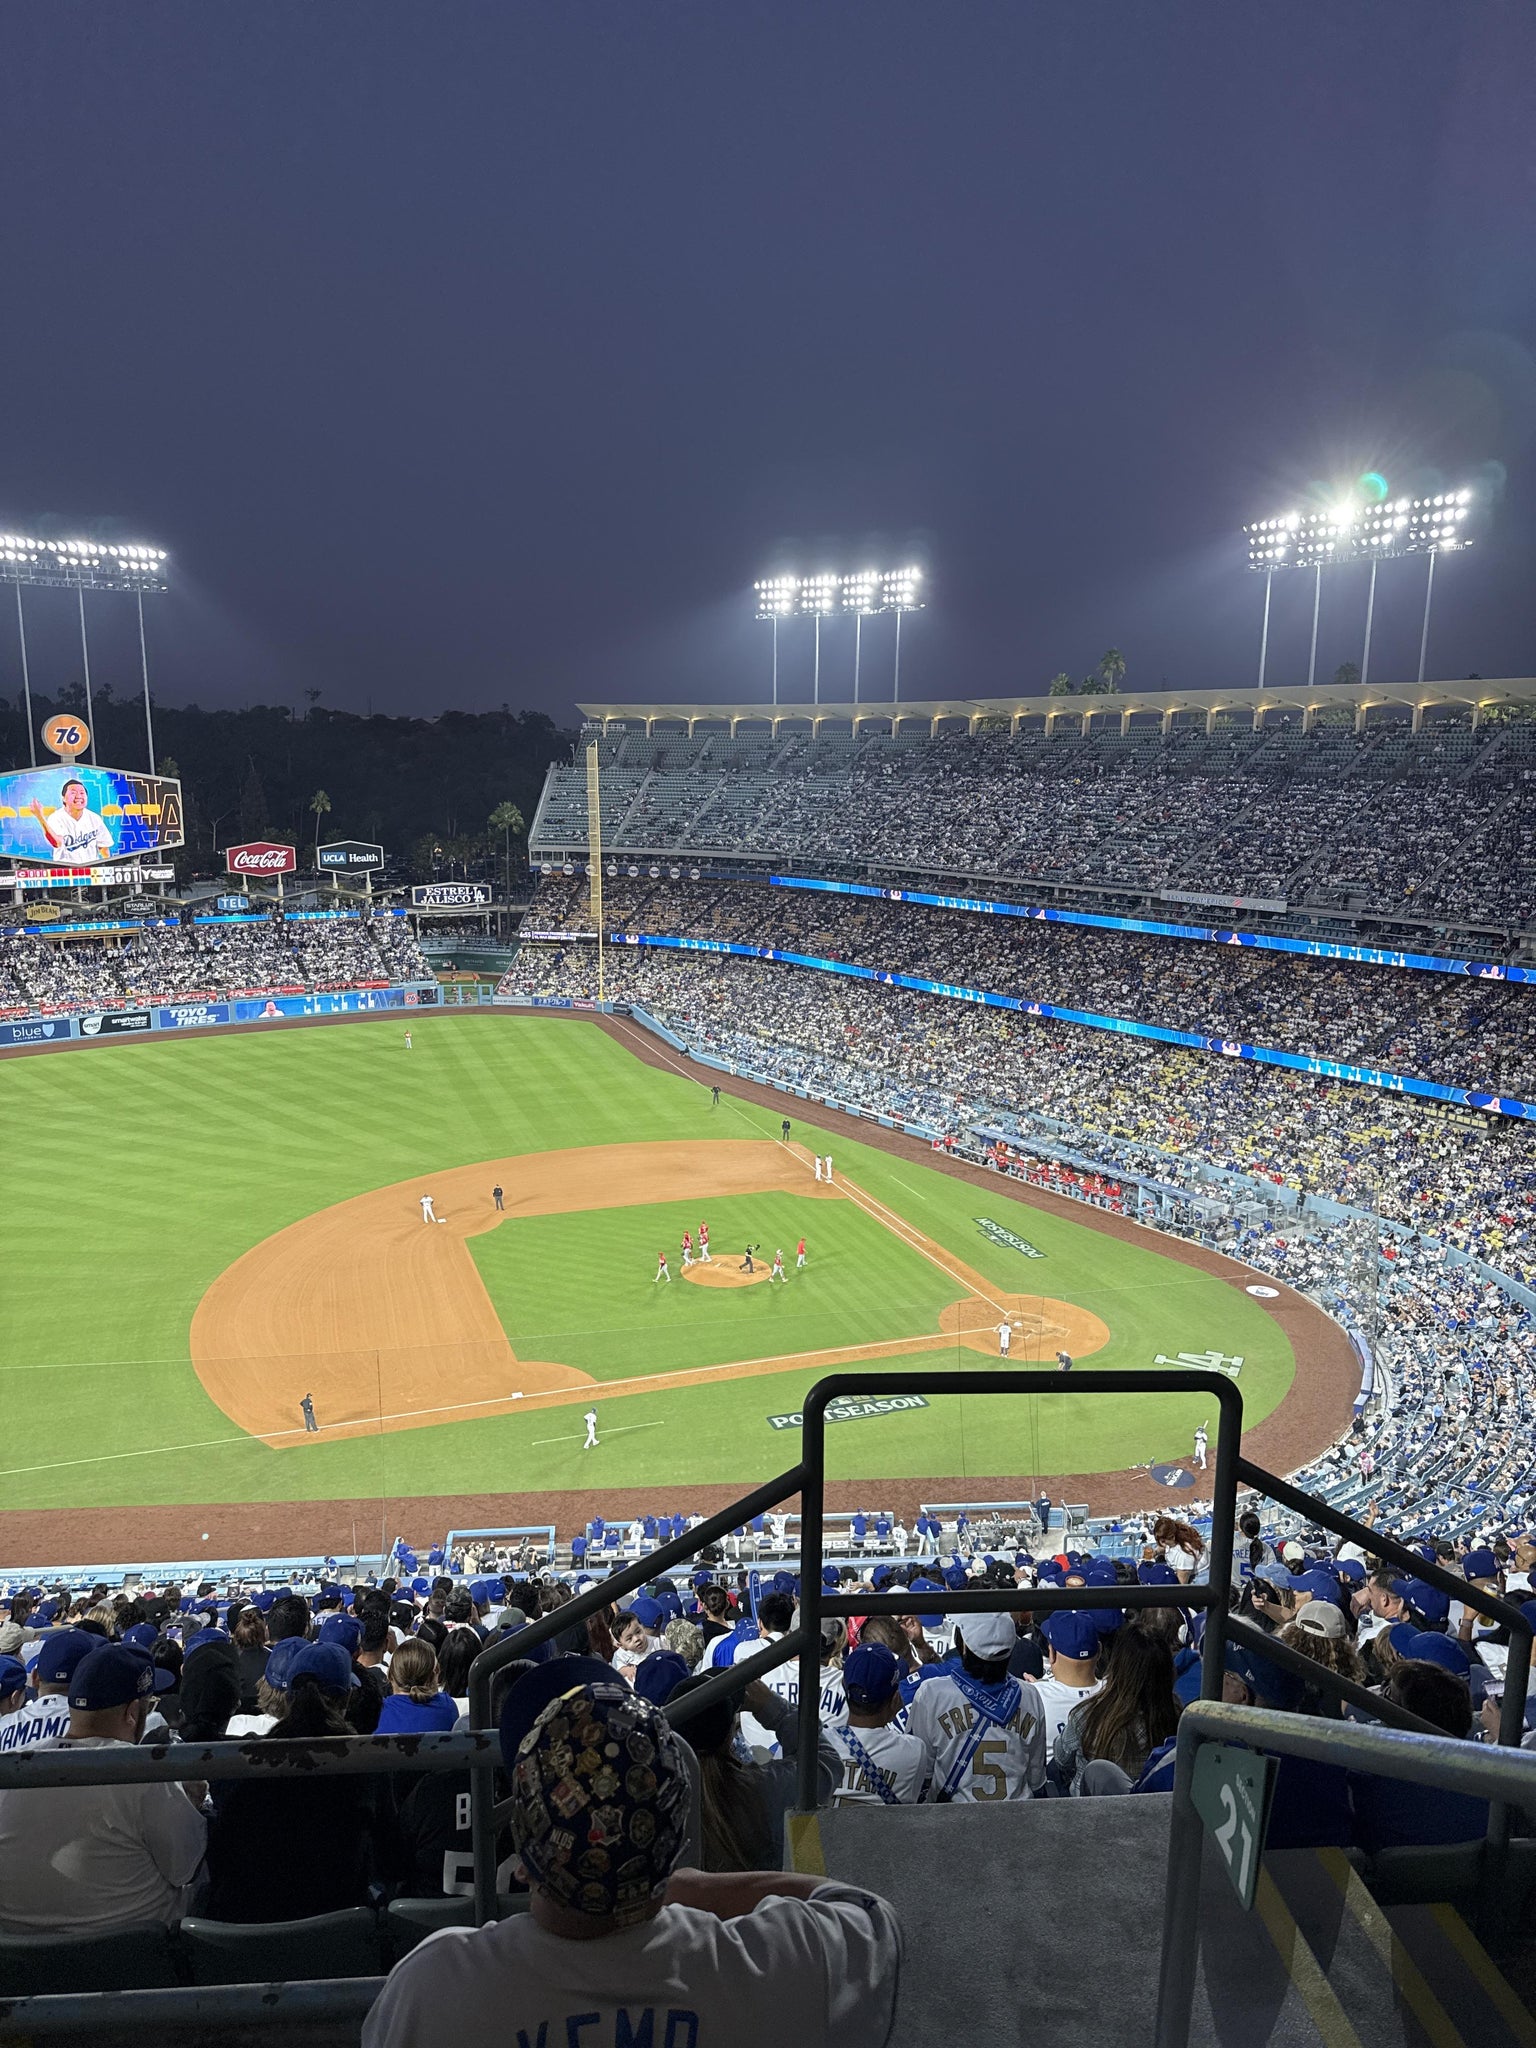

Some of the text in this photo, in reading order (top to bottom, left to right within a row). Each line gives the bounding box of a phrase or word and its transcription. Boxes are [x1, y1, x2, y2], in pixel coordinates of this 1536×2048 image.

[54, 726, 81, 745] 76
[234, 850, 289, 869] Coca-Cola
[323, 853, 379, 863] UCLA Health
[426, 886, 474, 896] ESTREL
[221, 898, 246, 908] TEL
[421, 895, 471, 904] JALISCO
[30, 905, 59, 917] JIM BEAM
[574, 1001, 595, 1009] Yakult
[169, 1007, 208, 1018] TOYO
[176, 1014, 217, 1026] TIRES
[13, 1026, 41, 1038] blue
[975, 1217, 1044, 1258] POSTSEASON
[771, 1396, 925, 1428] POTSEASON
[938, 1703, 1037, 1741] FREAN
[972, 1741, 1008, 1801] 5
[1214, 1783, 1252, 1900] 21
